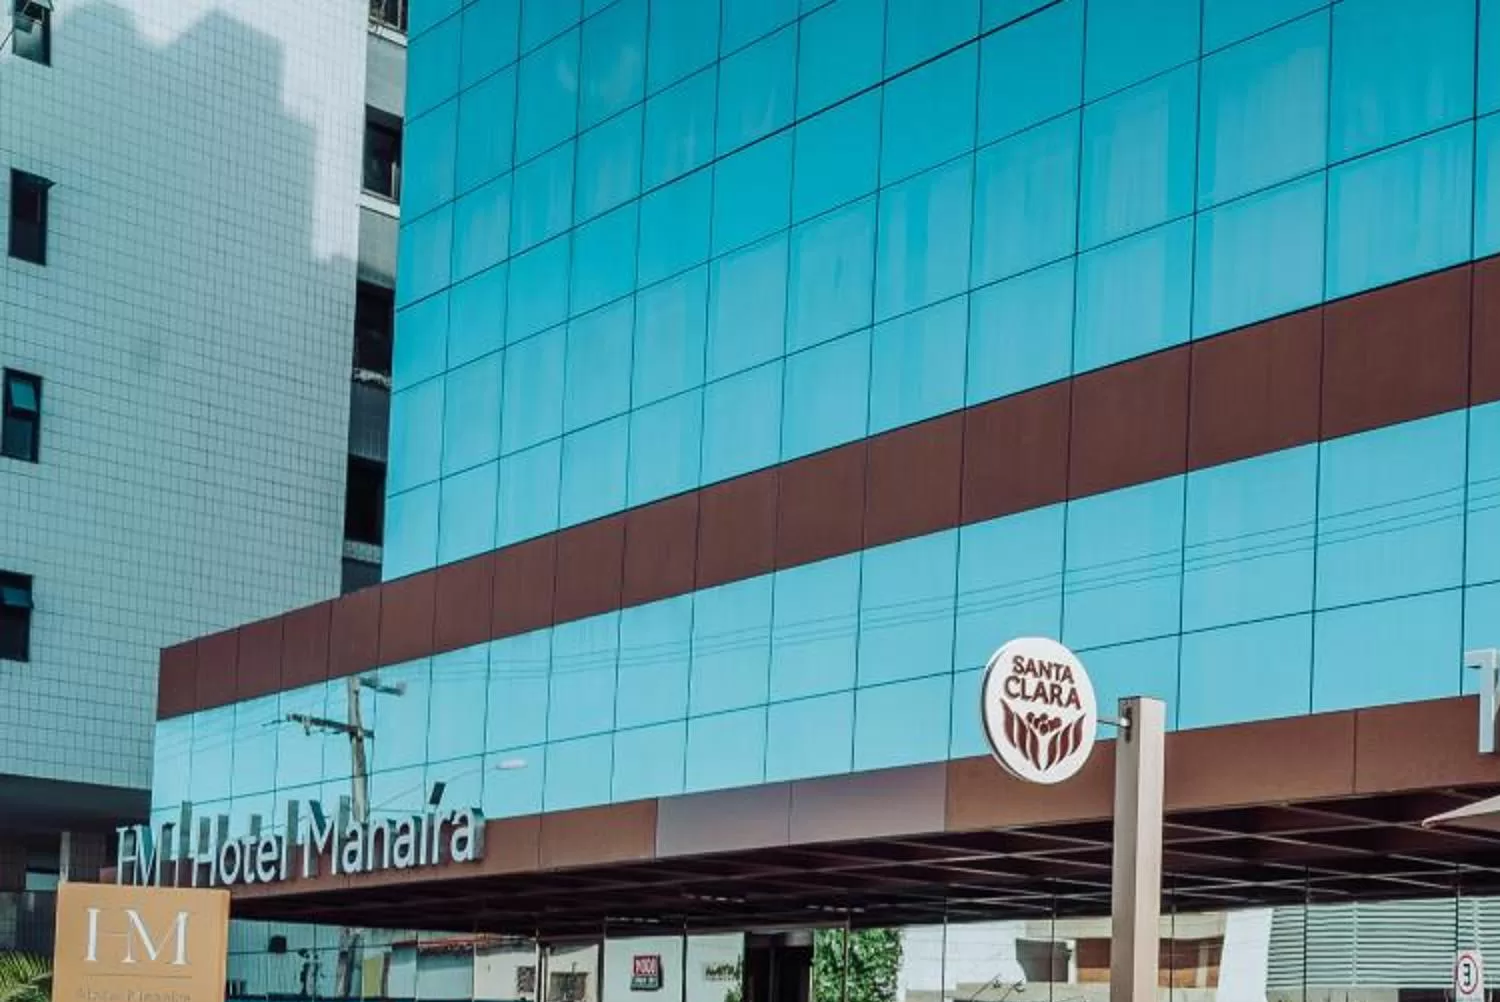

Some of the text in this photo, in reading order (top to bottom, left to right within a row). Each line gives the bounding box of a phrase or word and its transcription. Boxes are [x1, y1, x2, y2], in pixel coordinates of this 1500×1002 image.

[1012, 655, 1075, 685] SANTA
[1004, 676, 1082, 710] CLARA
[190, 803, 292, 887] Hotel
